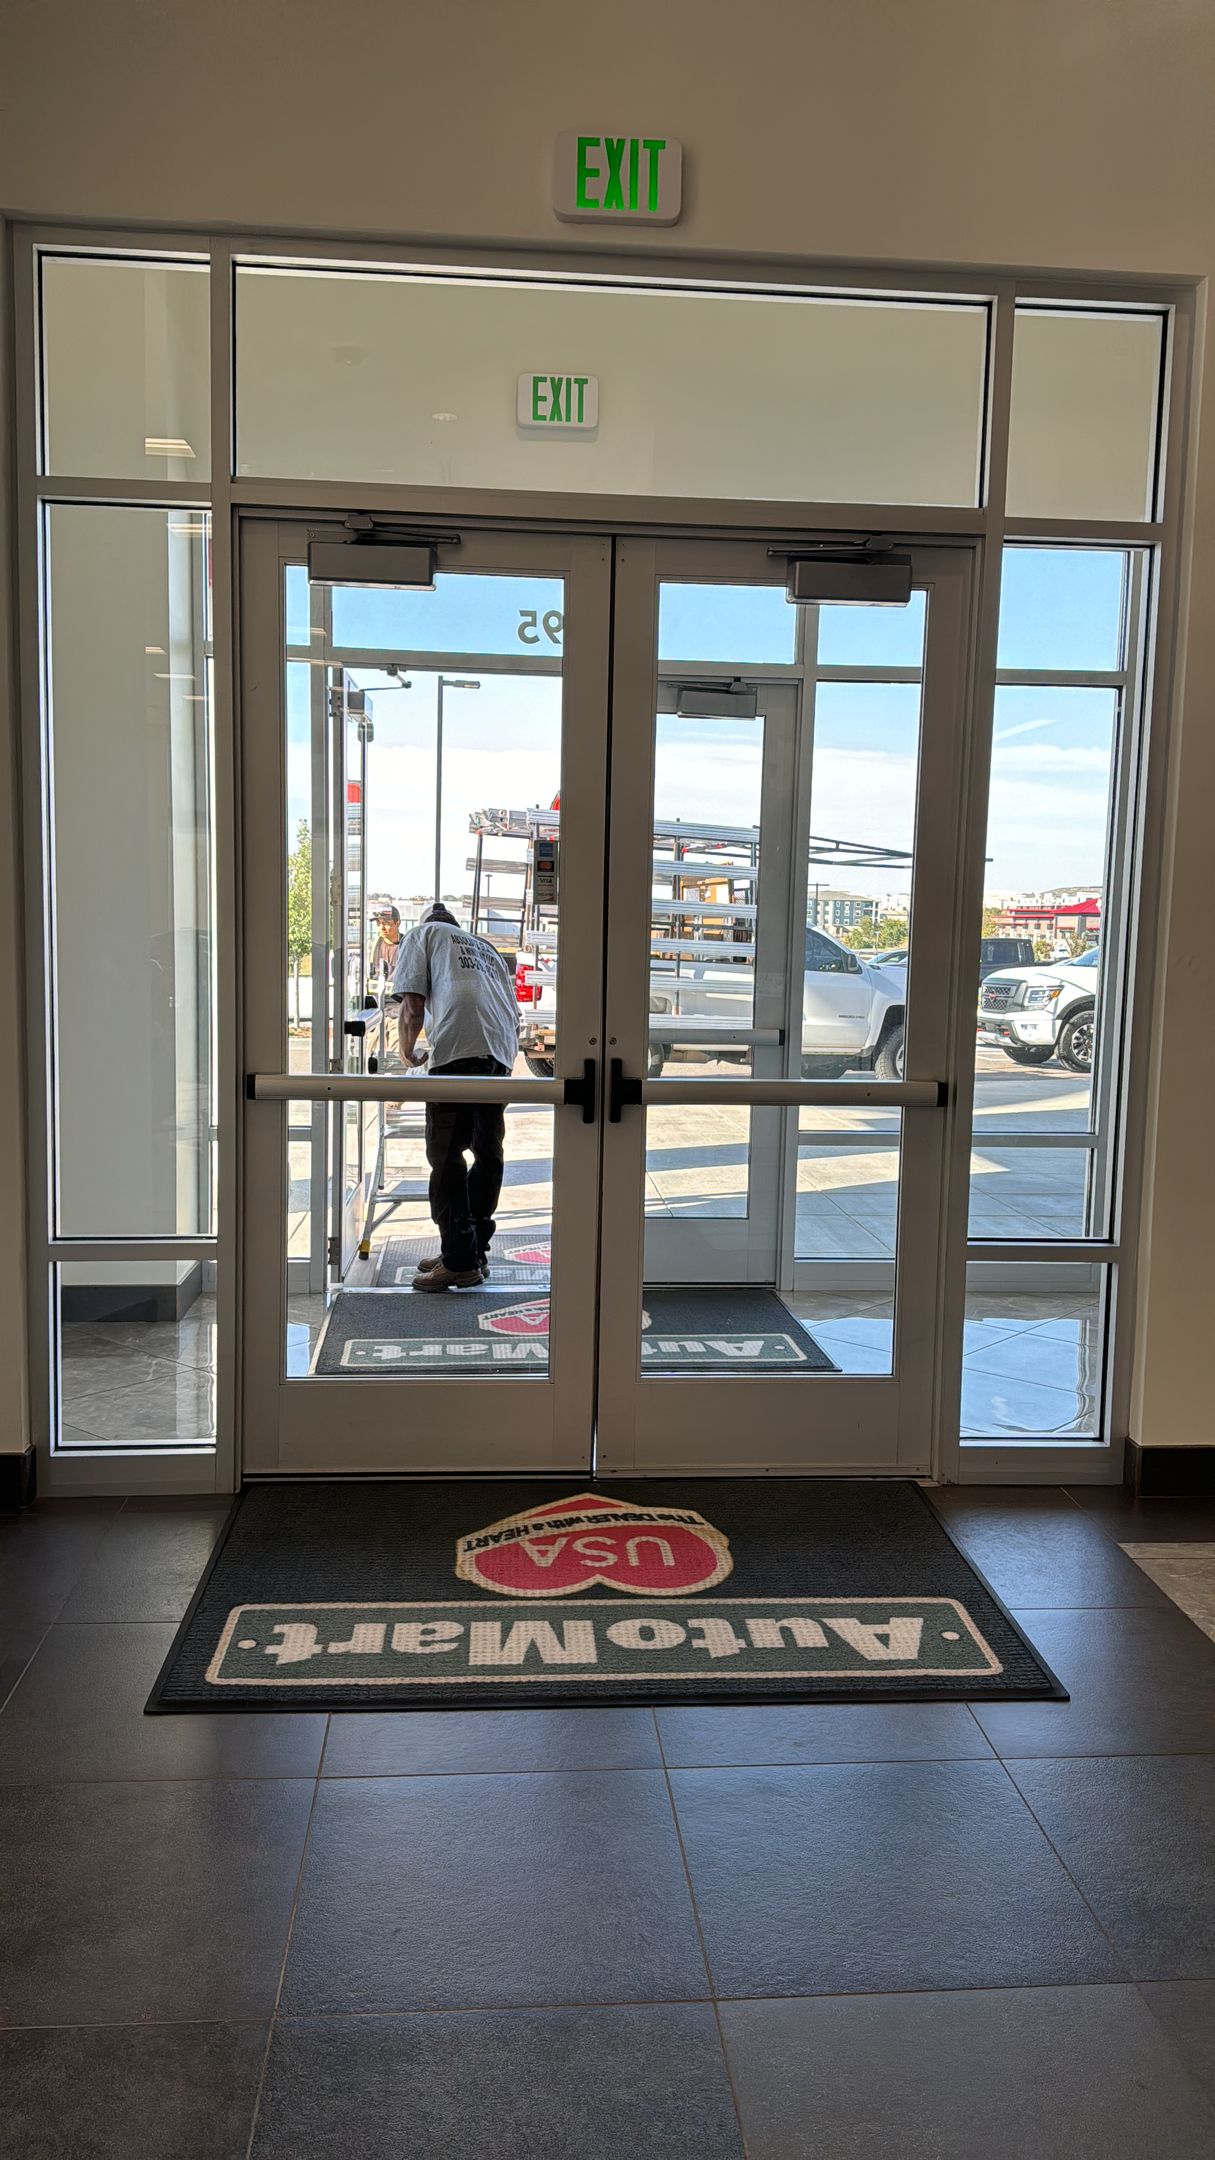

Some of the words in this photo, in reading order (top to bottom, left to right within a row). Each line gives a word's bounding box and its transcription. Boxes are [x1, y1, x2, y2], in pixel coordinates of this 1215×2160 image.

[576, 136, 666, 212] EXIT
[532, 375, 588, 423] EXIT
[531, 1522, 545, 1531] a
[545, 1515, 586, 1530] with
[584, 1512, 659, 1525] DEALER
[656, 1513, 705, 1526] The
[463, 1524, 530, 1553] HEART
[519, 1535, 676, 1568] USA
